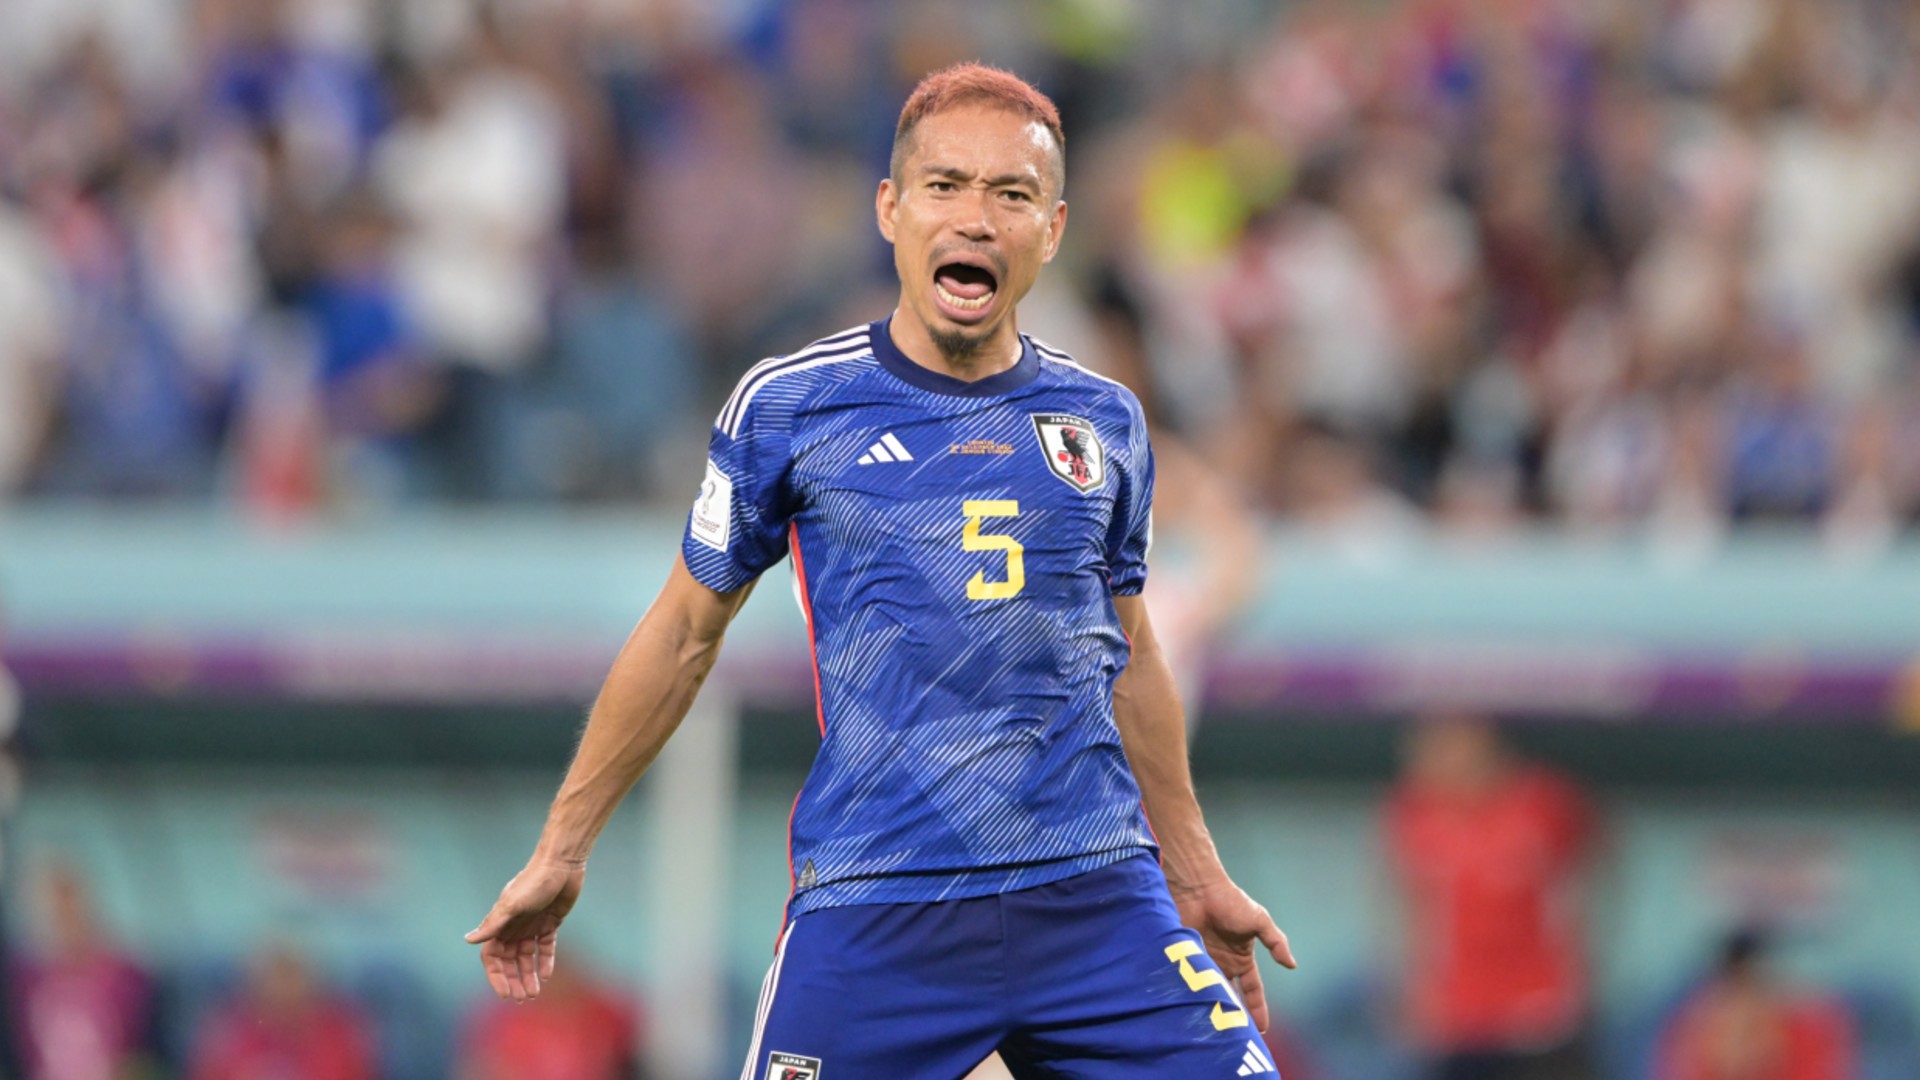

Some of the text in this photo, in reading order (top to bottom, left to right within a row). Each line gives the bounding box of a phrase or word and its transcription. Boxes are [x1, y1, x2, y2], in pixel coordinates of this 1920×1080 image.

[1050, 417, 1081, 426] JAPAN
[1068, 461, 1093, 480] JFA
[962, 500, 1025, 600] 5
[1164, 940, 1249, 1031] 5
[779, 1056, 807, 1066] JAPAN
